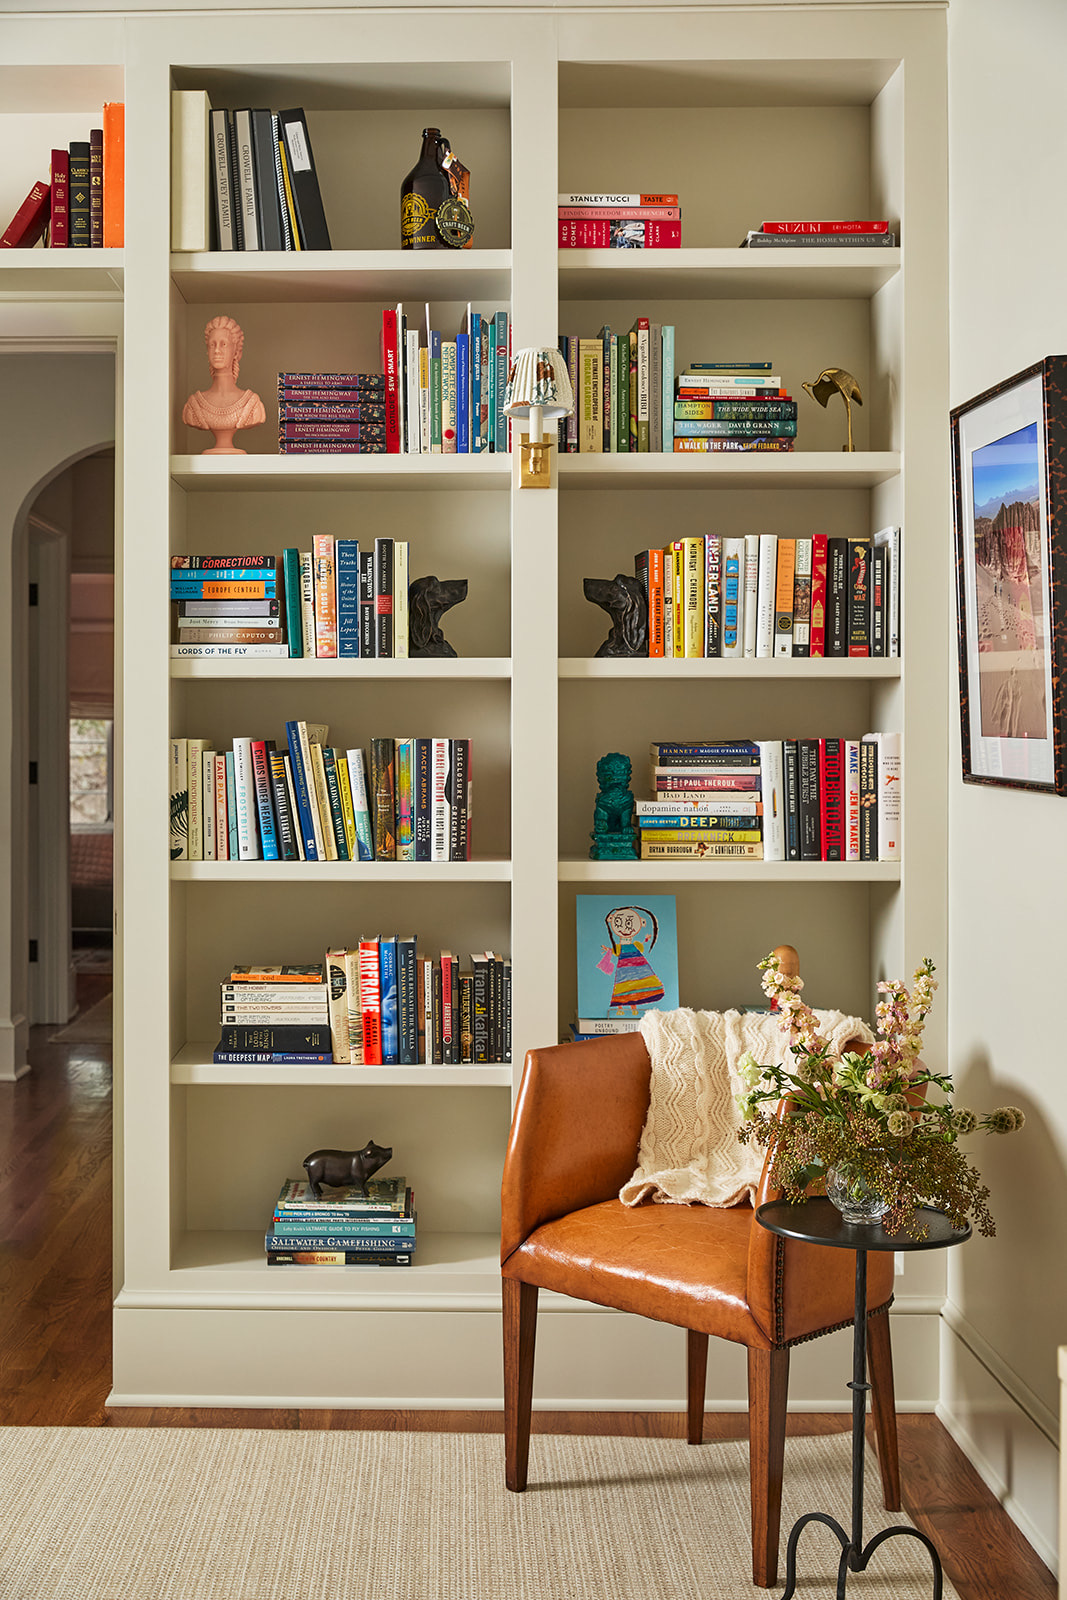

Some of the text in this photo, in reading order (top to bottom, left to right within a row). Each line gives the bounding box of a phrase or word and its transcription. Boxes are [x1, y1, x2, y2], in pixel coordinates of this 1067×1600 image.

[217, 133, 225, 171] CROWELL
[222, 200, 230, 228] FAMILY
[242, 145, 254, 217] CROWELL FAMILY
[778, 224, 821, 232] SUZUKI
[450, 416, 455, 426] TO
[202, 556, 264, 568] CORRECTIONS
[708, 539, 718, 613] UNDERLAND
[191, 746, 199, 760] the
[190, 780, 198, 825] menopause
[240, 786, 248, 841] FROSTBITE
[254, 749, 272, 835] CHAOS UNDER HEAVEN
[328, 775, 345, 845] READING WATER
[642, 805, 681, 814] dopamine
[825, 753, 841, 850] TOO BIG TO FAIL
[850, 746, 858, 854] AWAKE JEN HATMAKER
[436, 807, 444, 850] THE LOST WORLD
[678, 832, 734, 841] BREAKNECK
[680, 817, 718, 826] DEEP
[408, 950, 413, 958] BY
[360, 950, 380, 1013] AIRFRAME
[475, 969, 488, 1052] franz kafka
[229, 1054, 256, 1062] DEEPEST
[257, 1054, 270, 1062] MAP
[271, 1237, 395, 1247] SALTWATER GAMEFISHING
